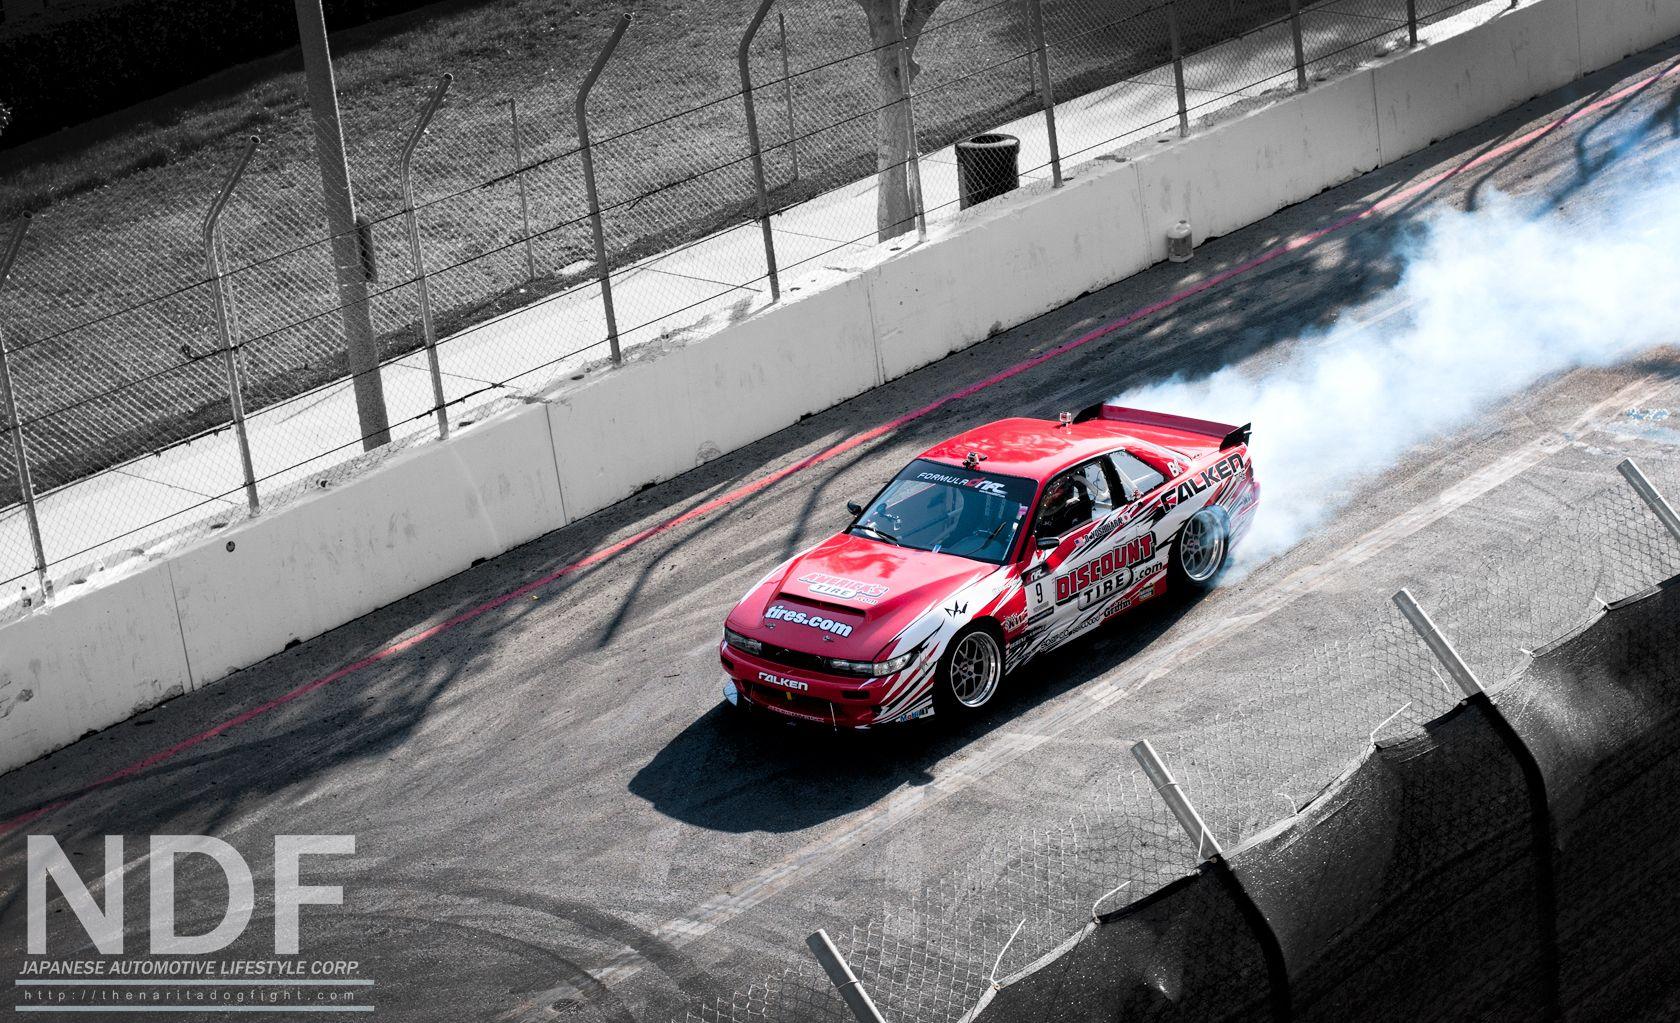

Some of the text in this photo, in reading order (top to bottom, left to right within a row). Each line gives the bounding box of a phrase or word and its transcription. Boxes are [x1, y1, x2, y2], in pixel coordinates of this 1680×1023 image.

[917, 472, 967, 486] FORMULA
[1161, 453, 1244, 512] FALKEN
[1055, 532, 1155, 603] DISCOUNT
[815, 584, 850, 596] TIRE
[1035, 582, 1044, 603] 9
[1084, 573, 1124, 604] TIRE
[764, 605, 853, 638] tires.com
[758, 671, 808, 691] FALKEN
